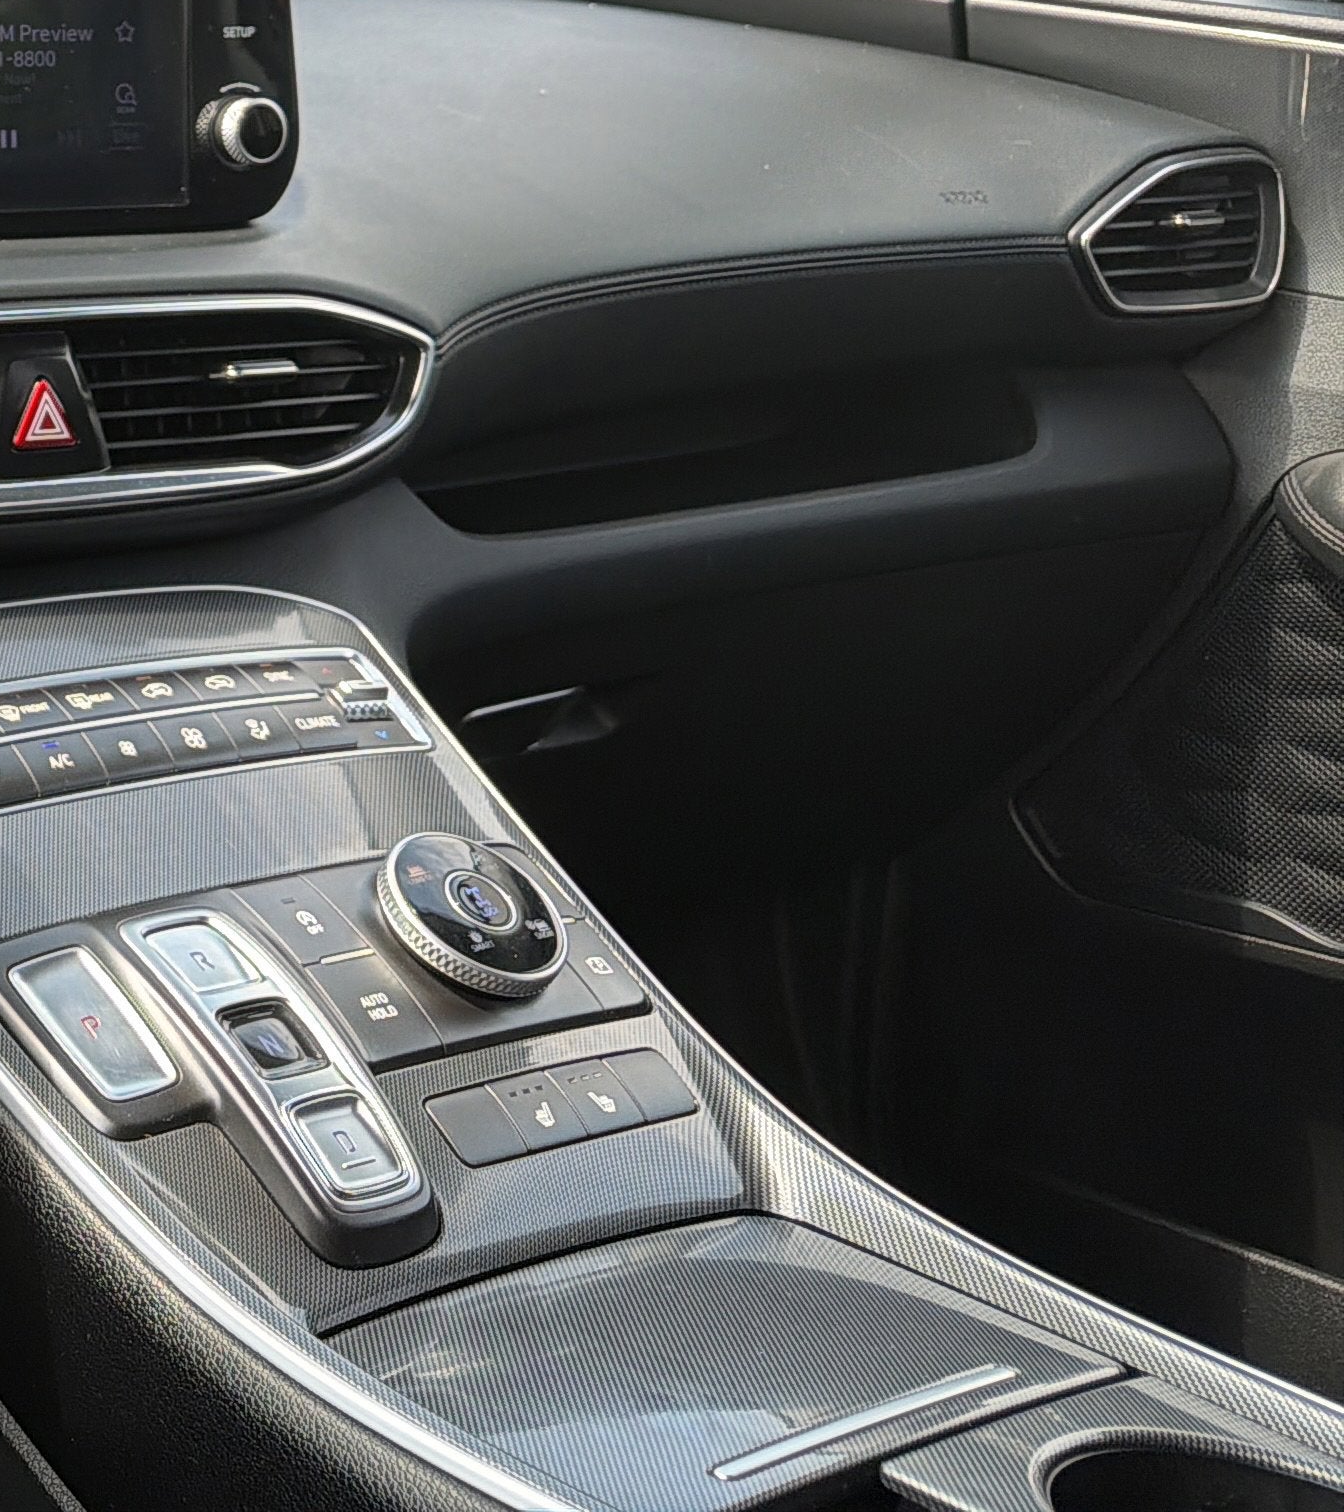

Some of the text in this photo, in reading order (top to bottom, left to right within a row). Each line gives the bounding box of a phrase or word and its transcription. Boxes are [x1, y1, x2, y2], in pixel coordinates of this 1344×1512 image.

[19, 23, 94, 43] Preview
[222, 25, 257, 39] SETUP
[48, 753, 75, 771] A/C
[189, 951, 215, 971] R
[360, 992, 389, 1008] AUTO
[367, 1005, 399, 1022] HOLD
[81, 1015, 101, 1040] P
[257, 1034, 284, 1058] N
[332, 1130, 356, 1155] D
